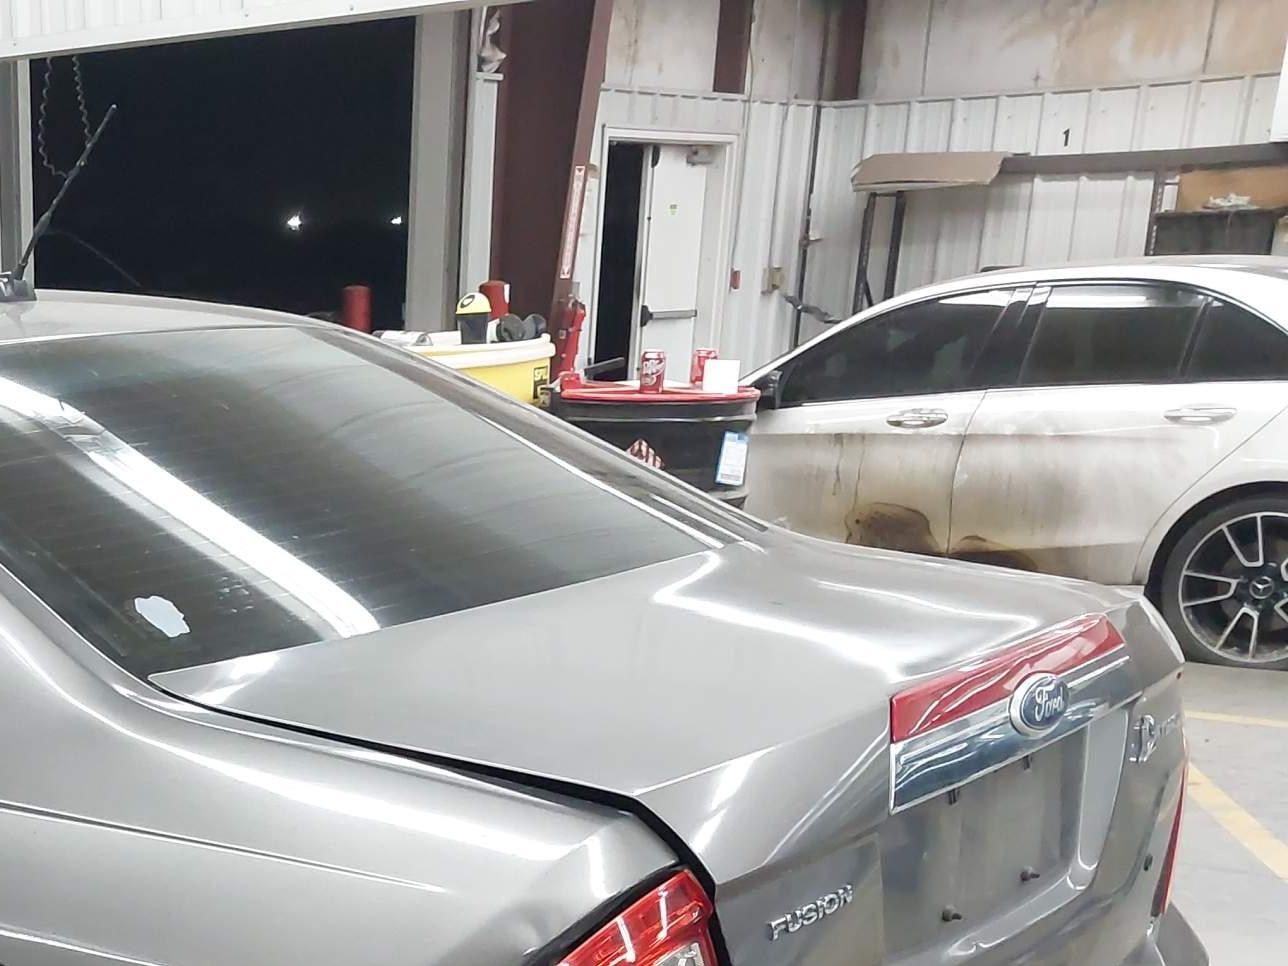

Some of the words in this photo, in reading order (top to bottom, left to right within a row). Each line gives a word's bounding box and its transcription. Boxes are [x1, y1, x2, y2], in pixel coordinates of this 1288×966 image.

[1063, 128, 1070, 147] 1
[1035, 684, 1064, 721] Ford
[767, 884, 853, 941] FUSION
